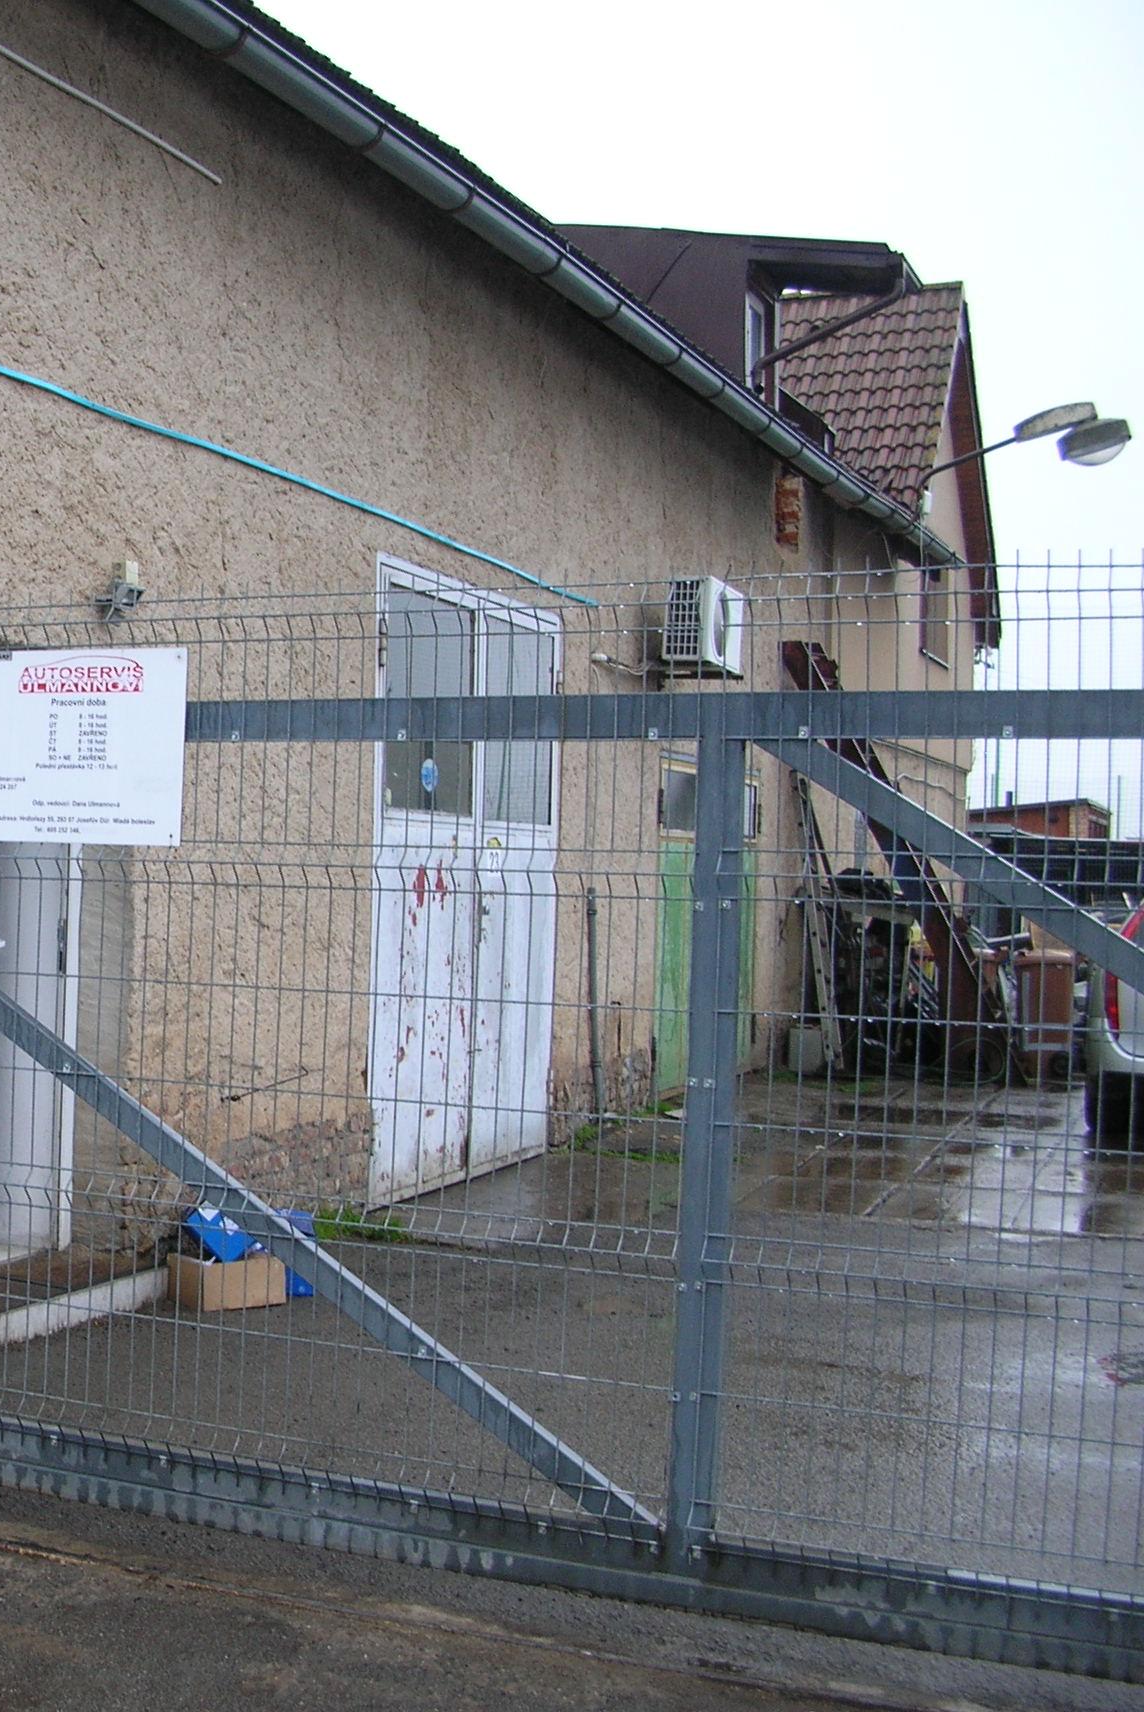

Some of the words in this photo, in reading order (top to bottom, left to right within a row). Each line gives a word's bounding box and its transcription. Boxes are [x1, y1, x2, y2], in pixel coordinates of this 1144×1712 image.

[20, 666, 143, 679] AUTOSERVIS
[19, 680, 143, 692] ULMANNOVI
[51, 697, 85, 706] Pracovní
[86, 697, 106, 706] doba
